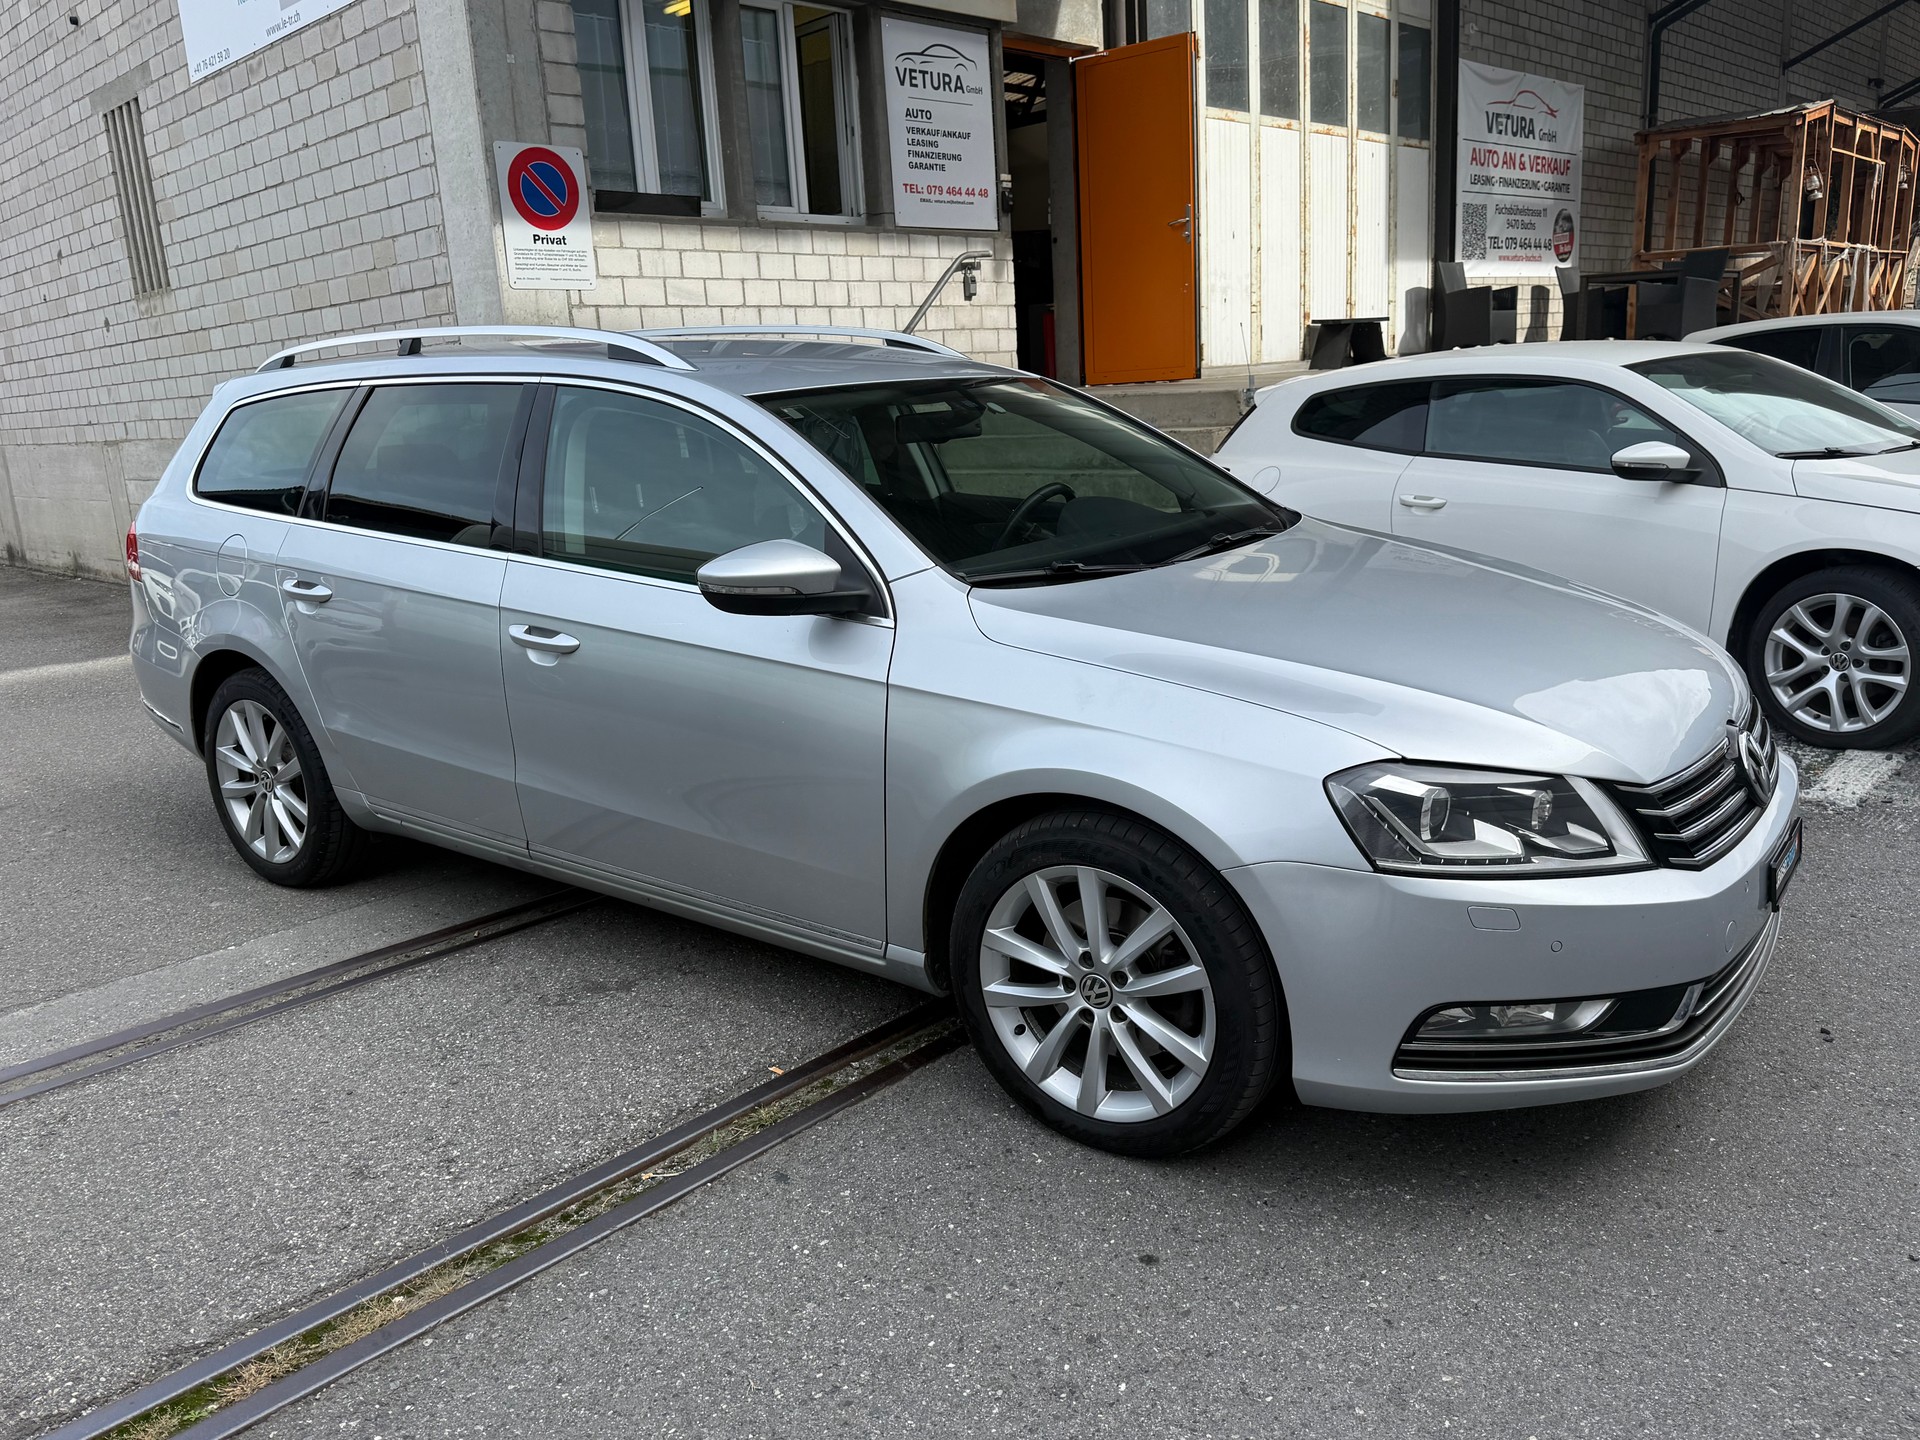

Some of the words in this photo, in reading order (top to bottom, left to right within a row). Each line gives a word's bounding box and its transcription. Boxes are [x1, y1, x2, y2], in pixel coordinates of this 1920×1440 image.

[265, 10, 300, 37] www.le-tr.ch
[895, 66, 965, 94] VETURA
[965, 85, 983, 95] GmbH
[905, 108, 932, 120] AUTO
[906, 126, 971, 140] VERKAUF/ANKAUF
[1485, 110, 1536, 140] VETURA
[1538, 128, 1557, 143] GmbH
[906, 138, 939, 149] LEASING
[907, 149, 962, 162] FINANZIERUNG
[1470, 147, 1500, 169] AUTO
[1501, 151, 1517, 171] AN
[1519, 153, 1527, 172] &
[1528, 154, 1571, 176] VERKAUF
[908, 161, 946, 172] GARANTIE
[1470, 173, 1496, 187] LEASING
[1498, 176, 1540, 191] FINANZIERUNG
[1543, 181, 1571, 194] GARANTIE
[902, 183, 924, 195] TEL:
[926, 184, 944, 196] 079
[946, 186, 962, 197] 464
[964, 187, 976, 198] 44
[978, 188, 989, 199] 48
[1506, 218, 1520, 230] 9470
[1520, 219, 1536, 231] Buchs
[532, 233, 568, 246] Privat
[1488, 236, 1503, 250] TEL:
[1504, 236, 1518, 250] 079
[1519, 237, 1532, 251] 464
[1533, 238, 1543, 251] 44
[1543, 238, 1553, 251] 48
